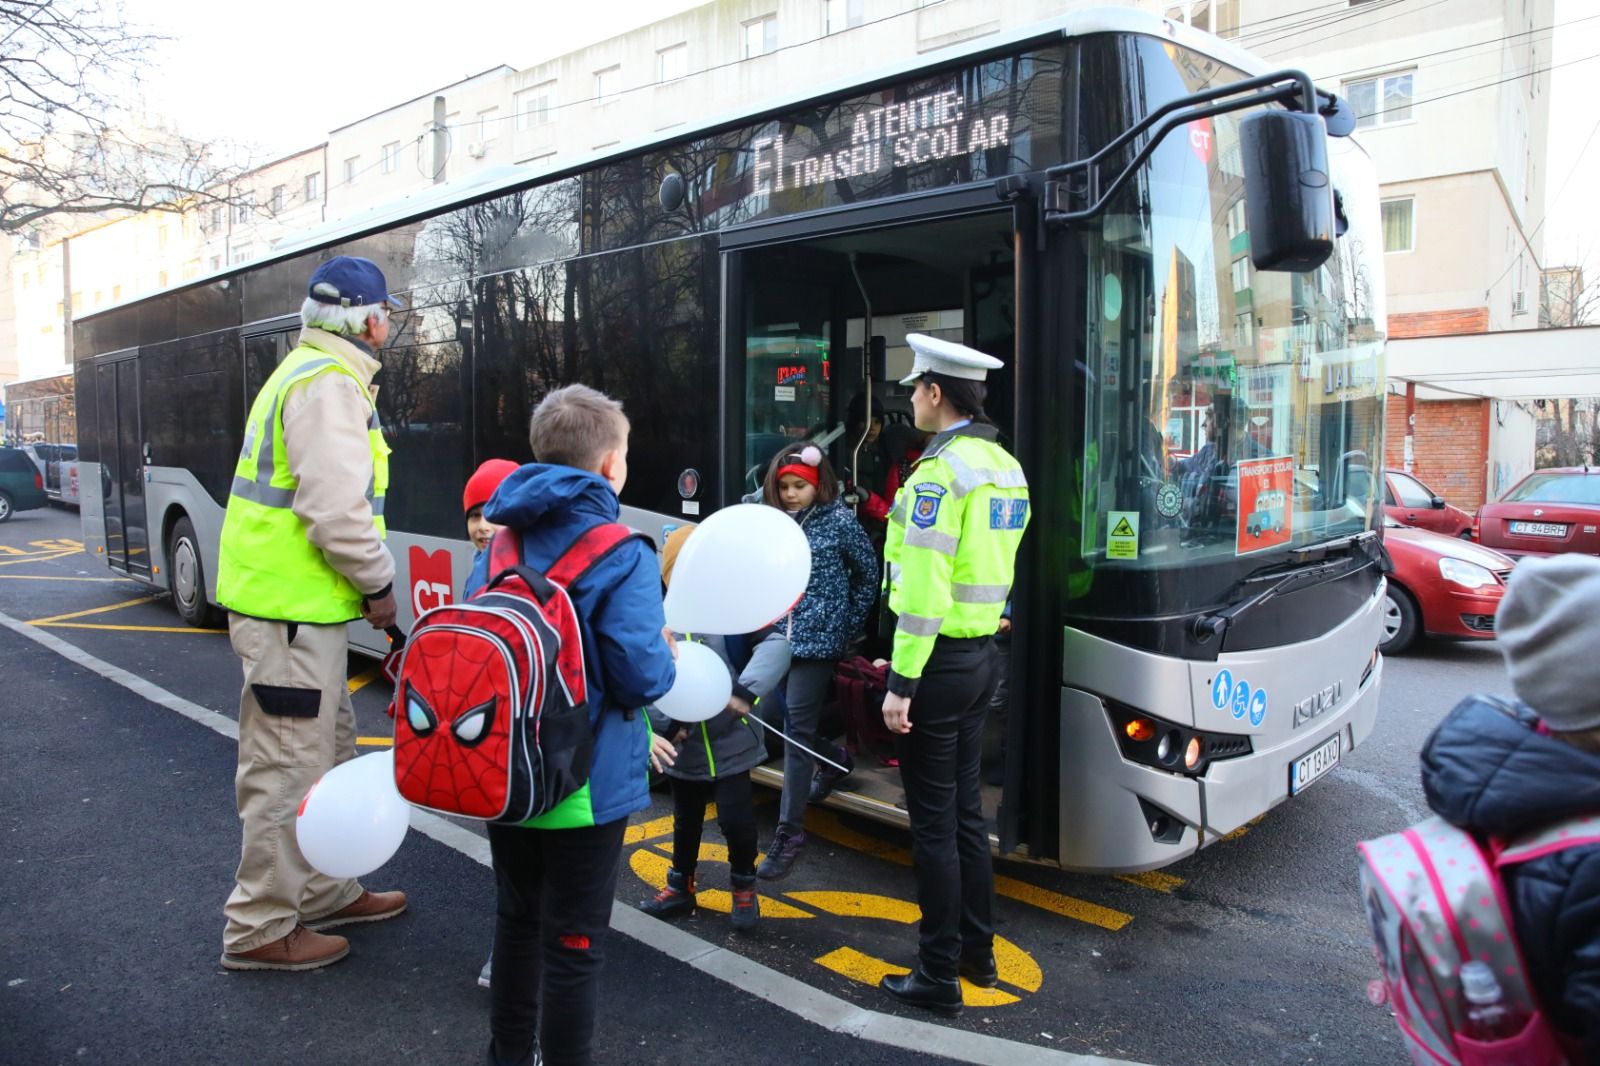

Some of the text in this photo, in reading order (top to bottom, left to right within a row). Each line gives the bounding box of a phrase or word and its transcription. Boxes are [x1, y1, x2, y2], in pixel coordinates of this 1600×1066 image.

[852, 90, 963, 144] ATENTIE:
[791, 114, 1009, 188] TRASEU SCOLAR
[1190, 130, 1209, 150] CT
[1516, 523, 1565, 535] CT 94 BRH
[414, 579, 451, 618] CT
[1292, 680, 1342, 729] ISUZU
[1300, 757, 1311, 784] CT
[1313, 750, 1322, 775] 13
